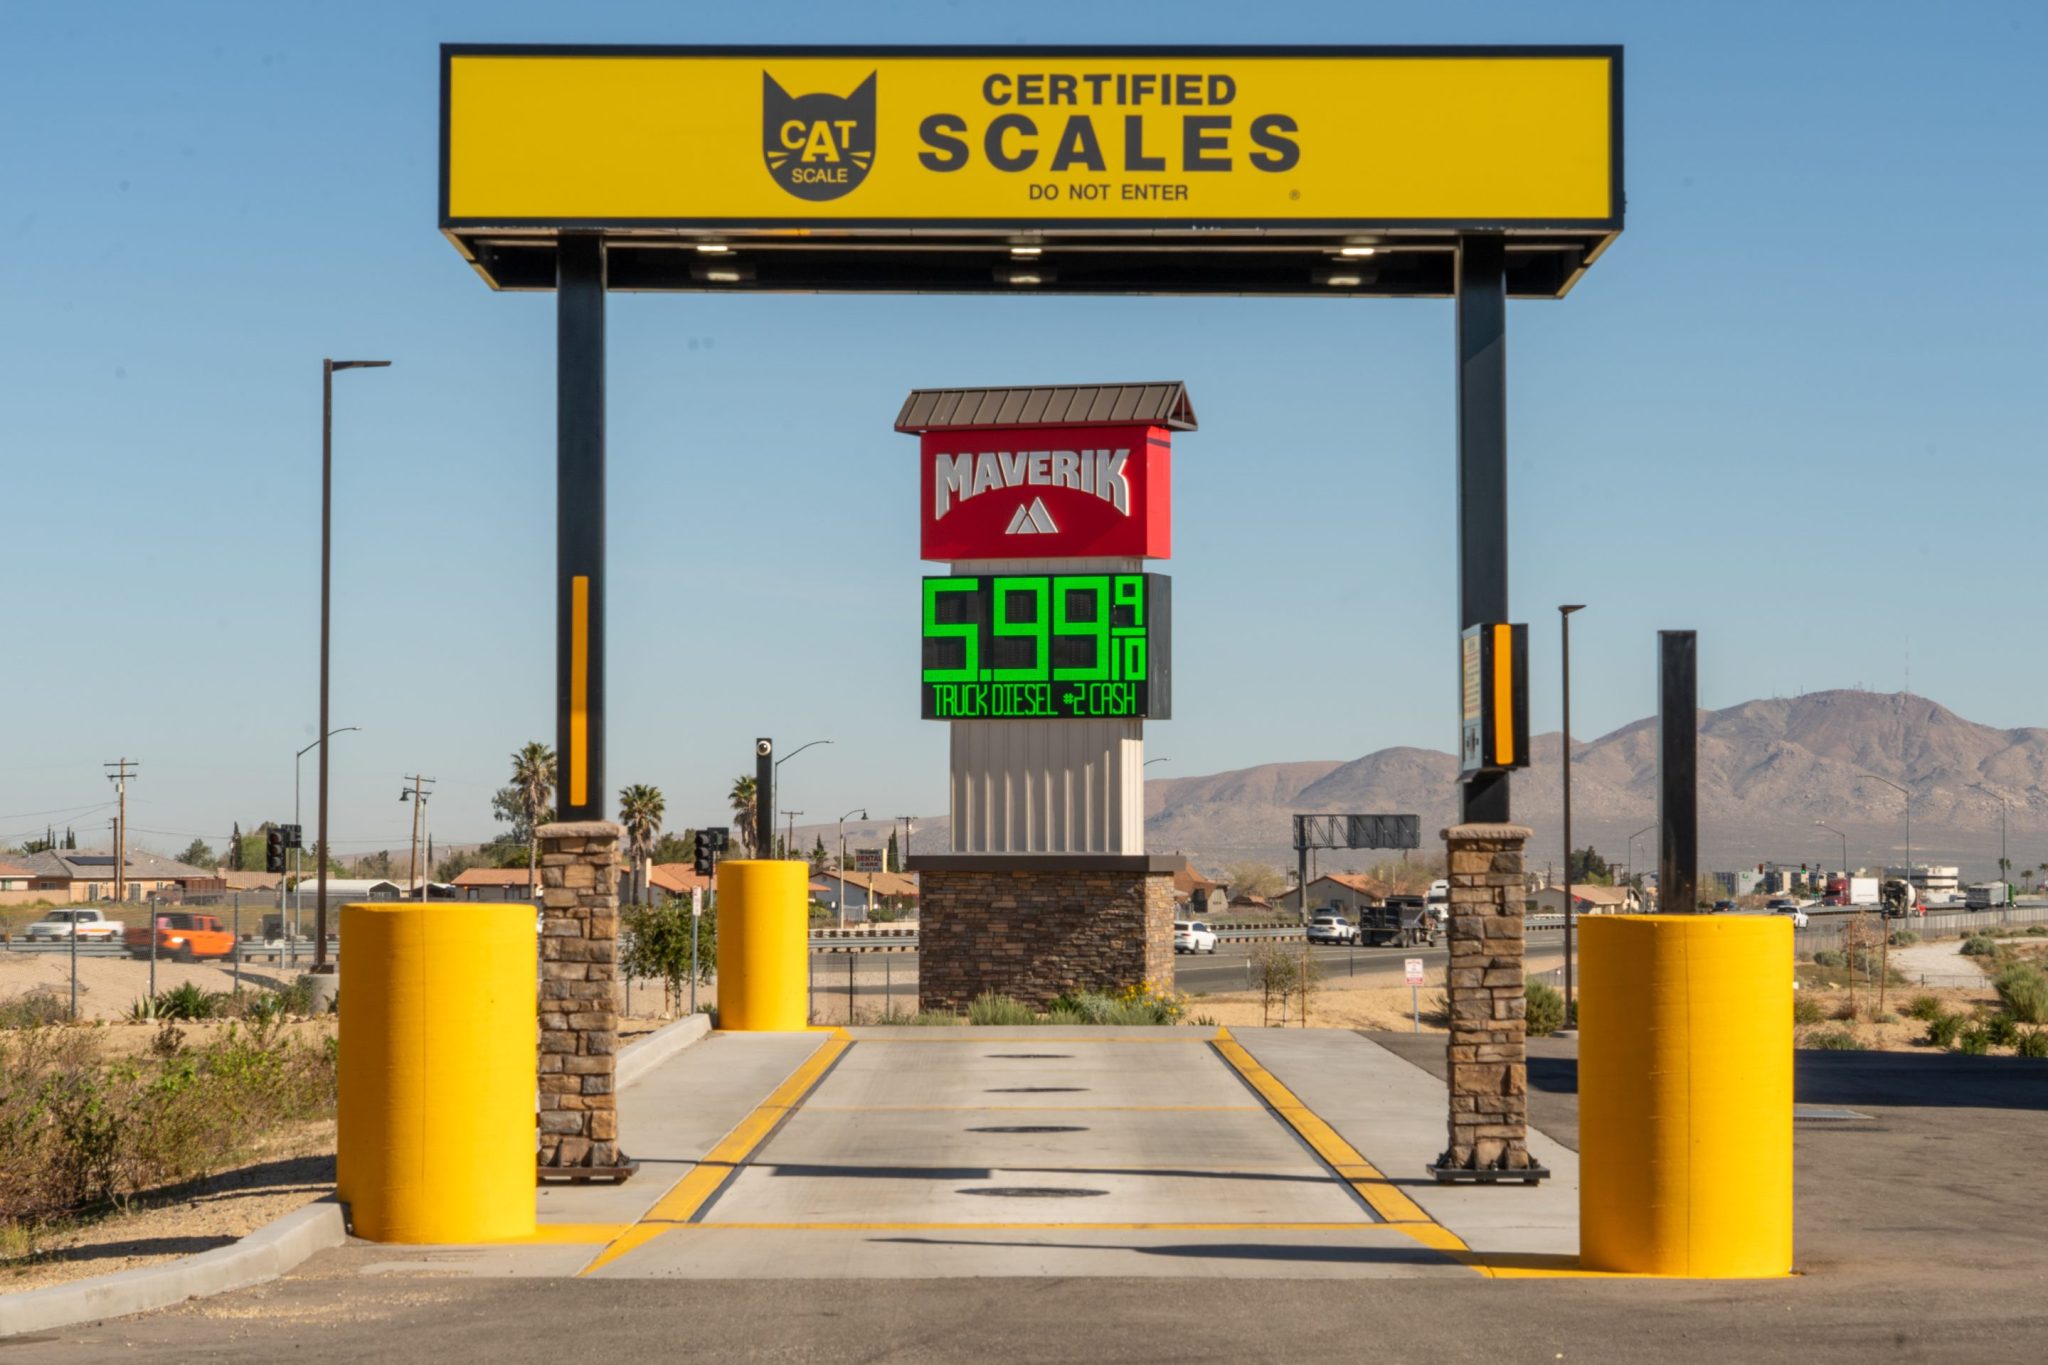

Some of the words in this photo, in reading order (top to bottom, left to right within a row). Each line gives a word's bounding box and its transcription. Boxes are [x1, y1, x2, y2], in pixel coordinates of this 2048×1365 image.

[982, 73, 1237, 106] CERTIFIED
[780, 119, 857, 163] CAT
[918, 113, 1301, 173] SCALES
[791, 167, 849, 184] SCALE
[1029, 184, 1059, 200] DO
[1069, 184, 1110, 200] NOT
[1121, 184, 1189, 200] ENTER
[935, 448, 1131, 521] MAVERIK
[932, 684, 988, 717] TRUCK
[992, 684, 1059, 716] DIESEL
[1089, 682, 1136, 715] CASH
